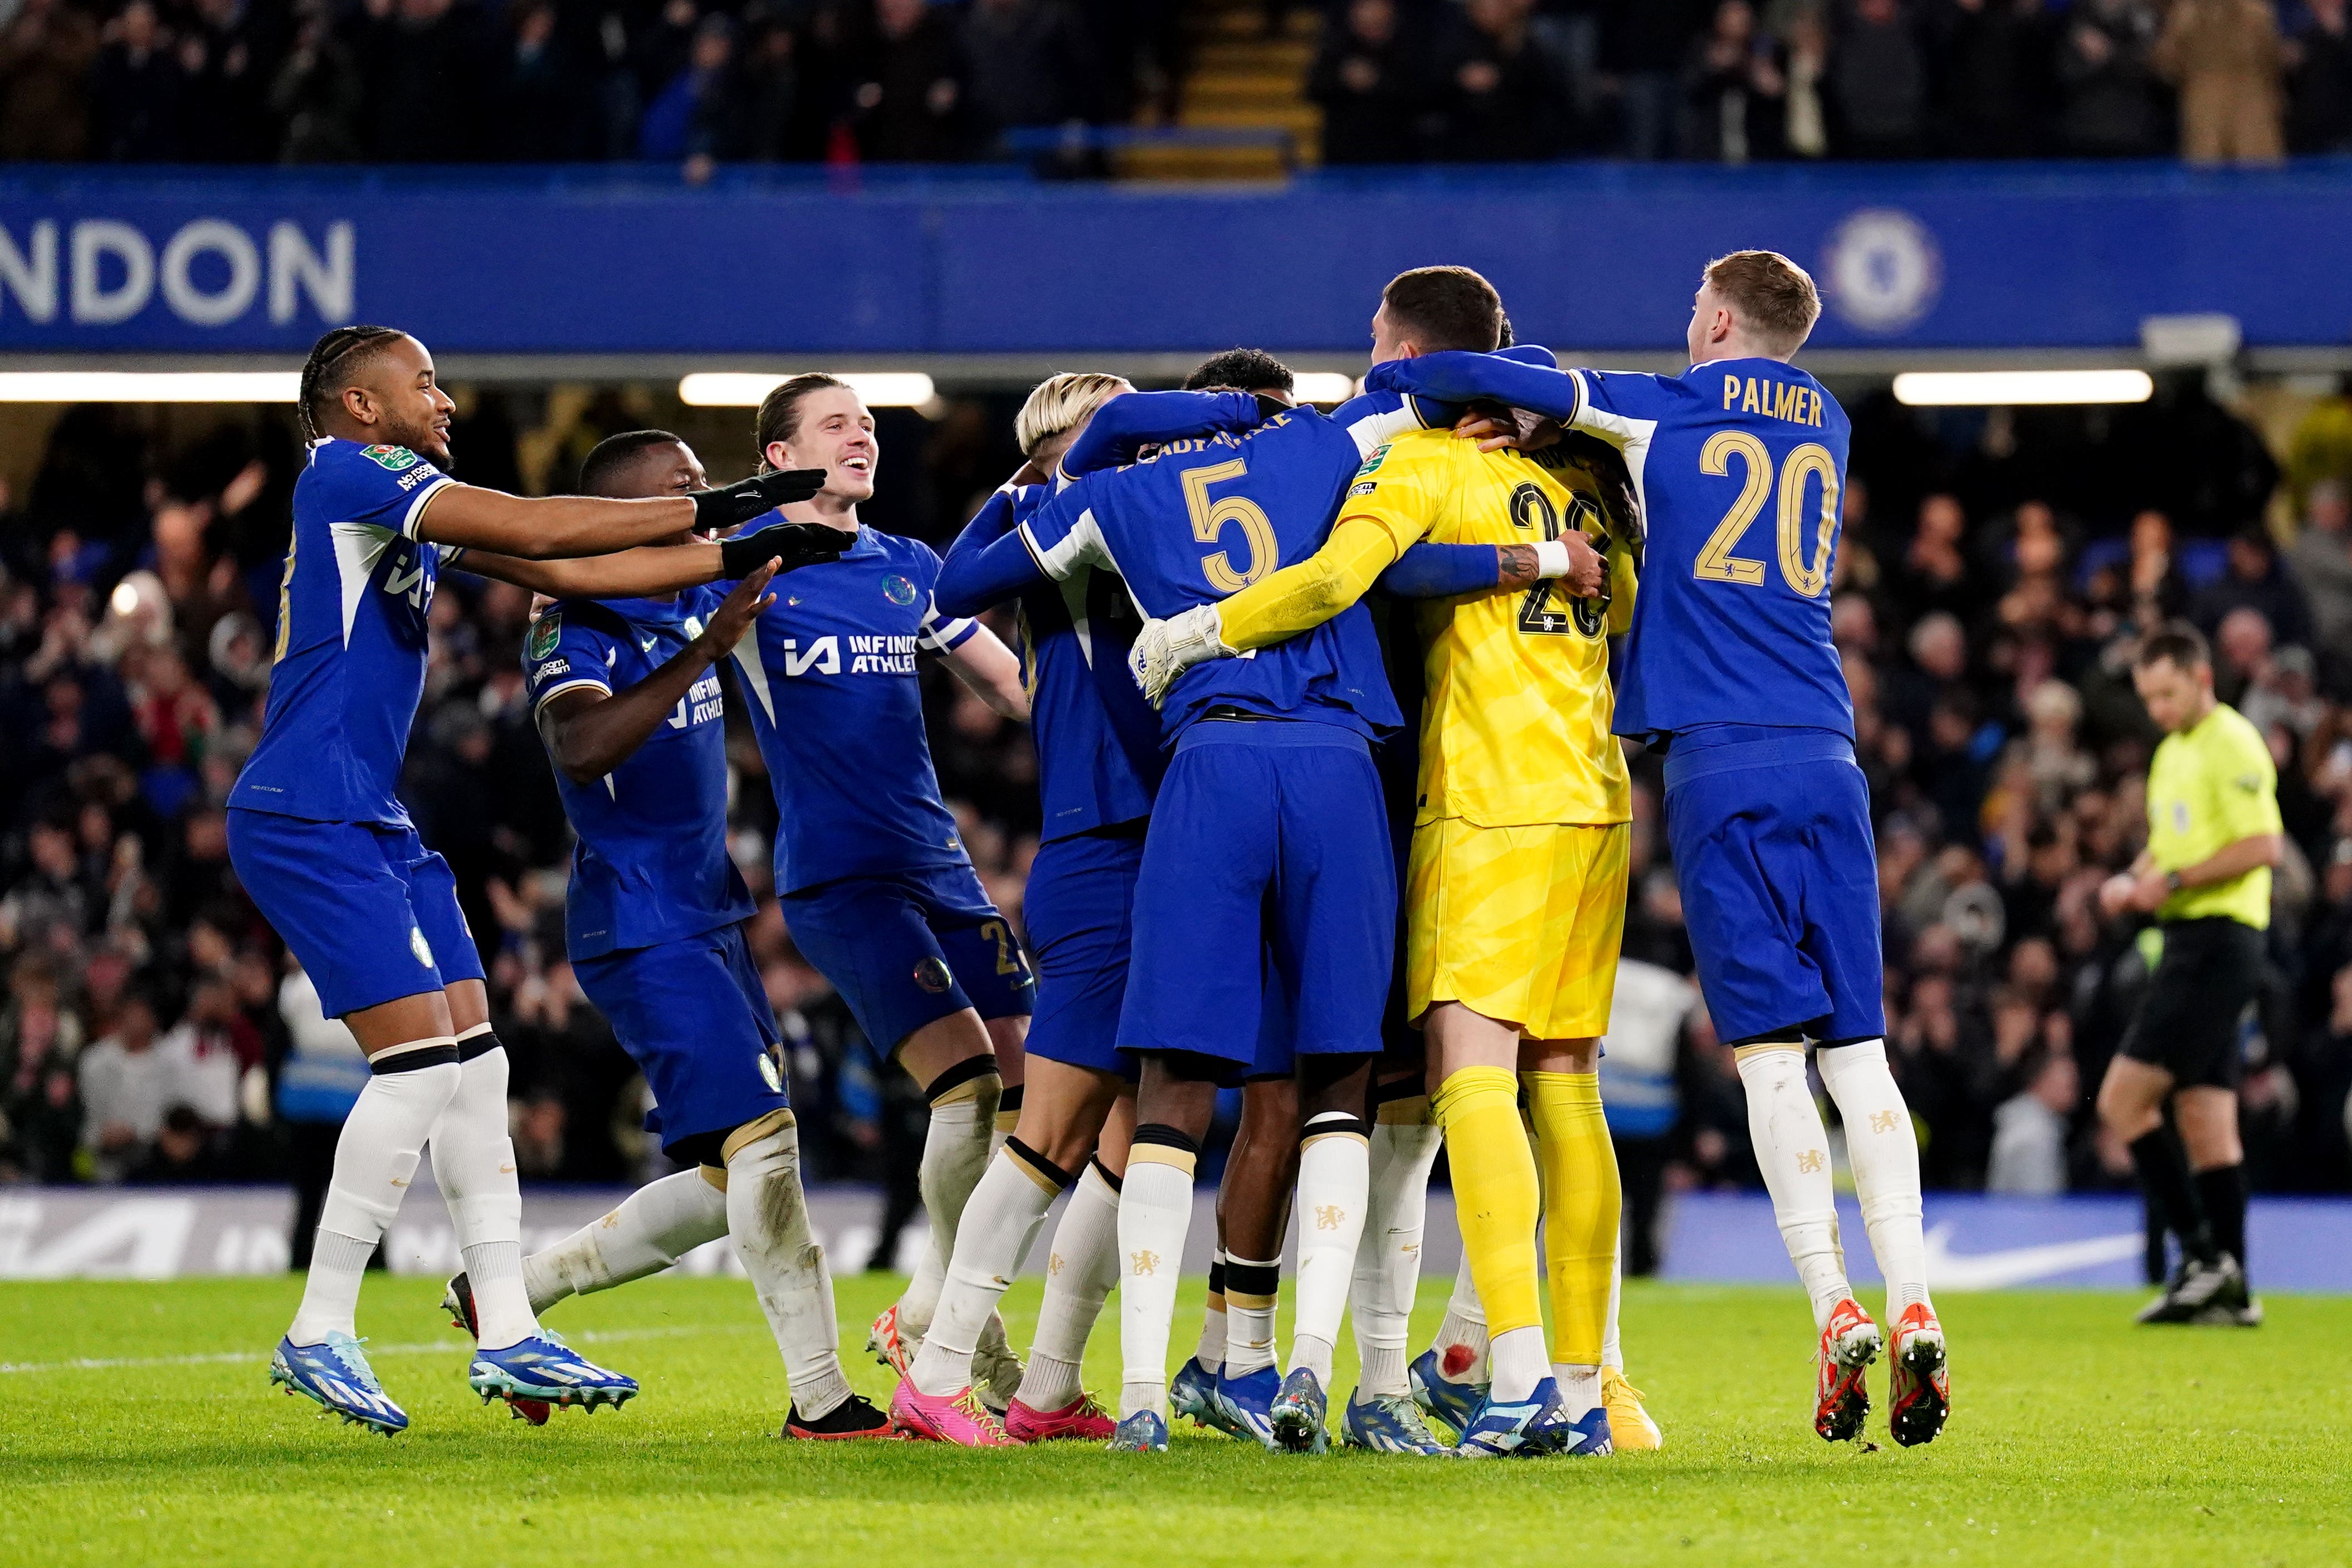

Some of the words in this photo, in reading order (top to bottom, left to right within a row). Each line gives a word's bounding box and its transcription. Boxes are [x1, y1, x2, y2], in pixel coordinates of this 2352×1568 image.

[1724, 374, 1822, 428] PALMER
[1180, 457, 1279, 593] 5
[1694, 430, 1839, 598] 20
